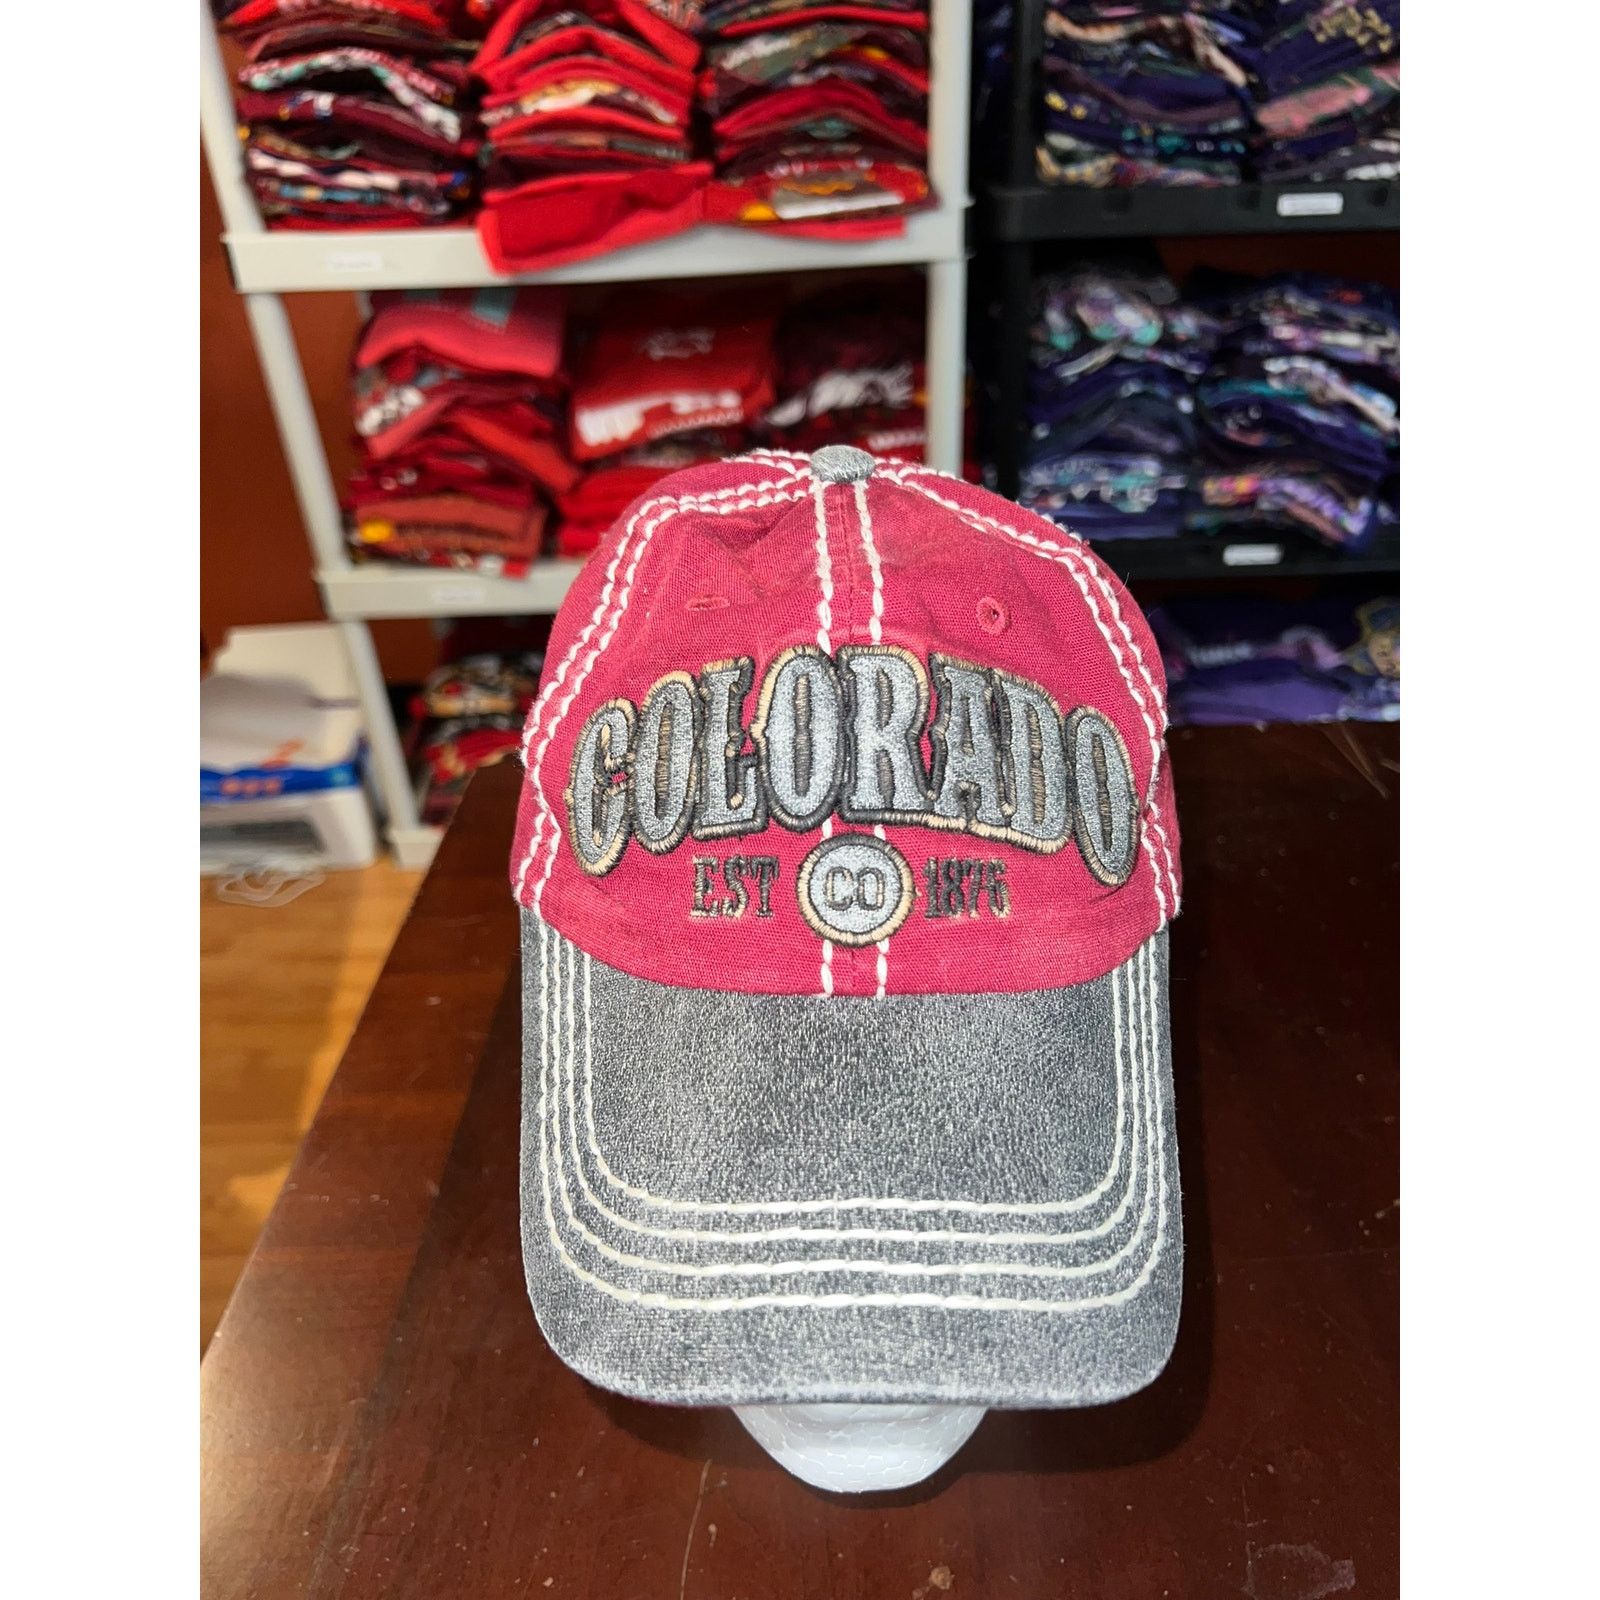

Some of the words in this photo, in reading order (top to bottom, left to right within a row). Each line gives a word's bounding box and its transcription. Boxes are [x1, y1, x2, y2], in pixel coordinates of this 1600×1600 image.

[565, 645, 1139, 886] COLORADO
[690, 855, 779, 918] EST
[825, 866, 886, 911] CO
[923, 856, 1011, 918] 1876
